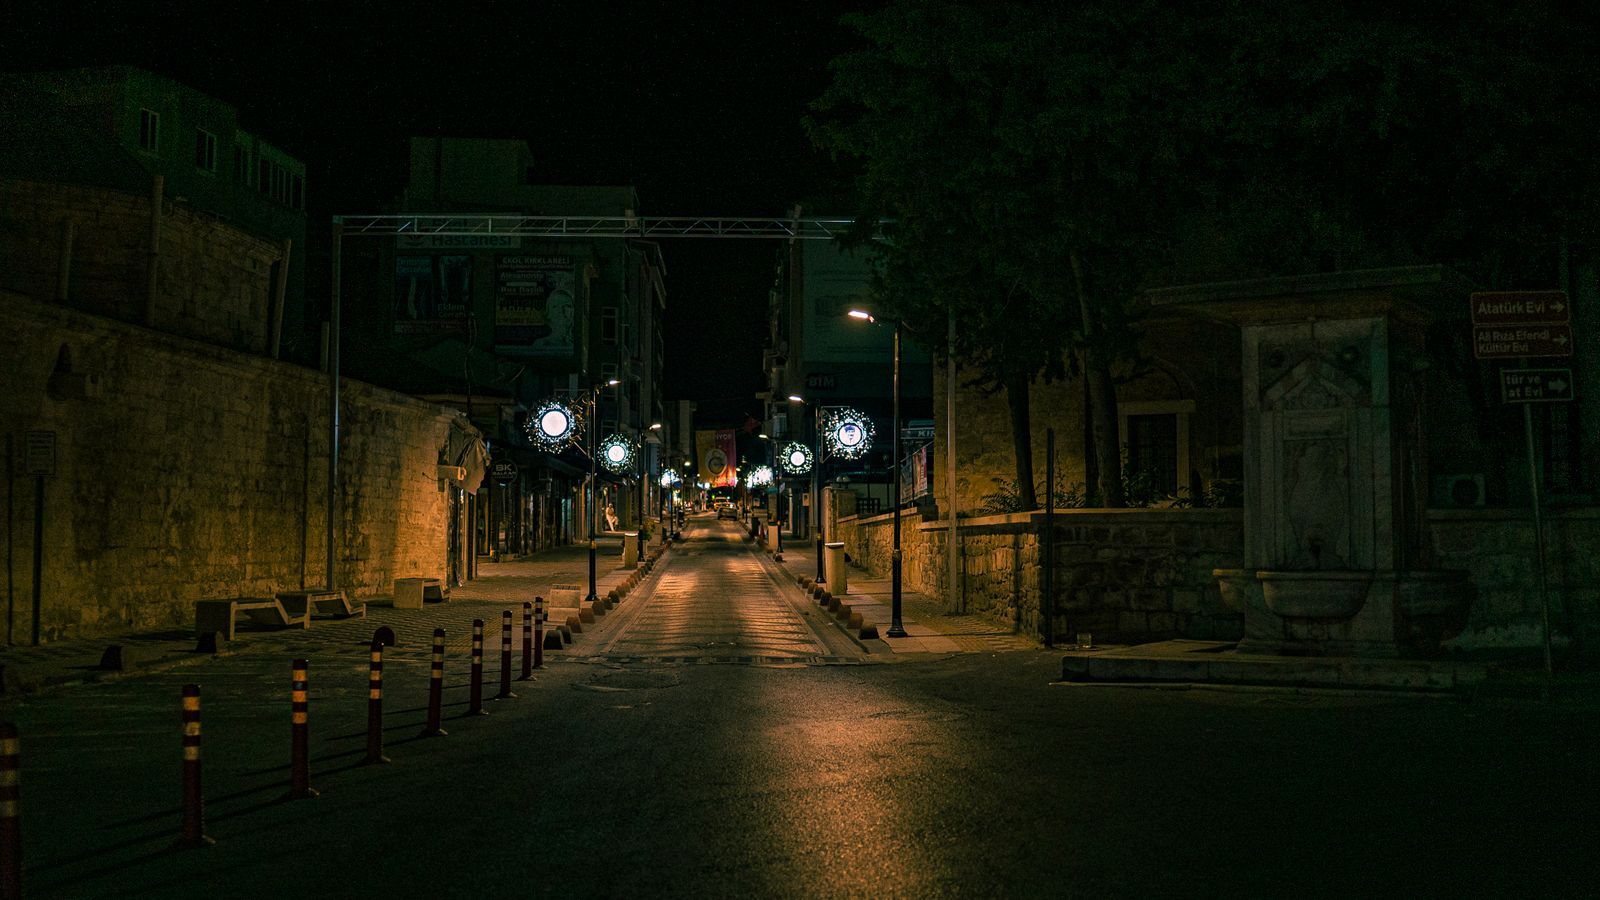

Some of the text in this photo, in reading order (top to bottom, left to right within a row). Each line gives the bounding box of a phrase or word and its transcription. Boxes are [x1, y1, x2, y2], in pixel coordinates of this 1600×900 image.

[432, 234, 512, 246] Hastanesi
[1477, 300, 1545, 315] Atatürk Evi
[1478, 330, 1491, 342] Ali
[1516, 329, 1550, 341] Efendi
[1478, 341, 1529, 354] Kültür Evi
[1506, 373, 1541, 385] tür ve
[1508, 385, 1543, 398] at Evi
